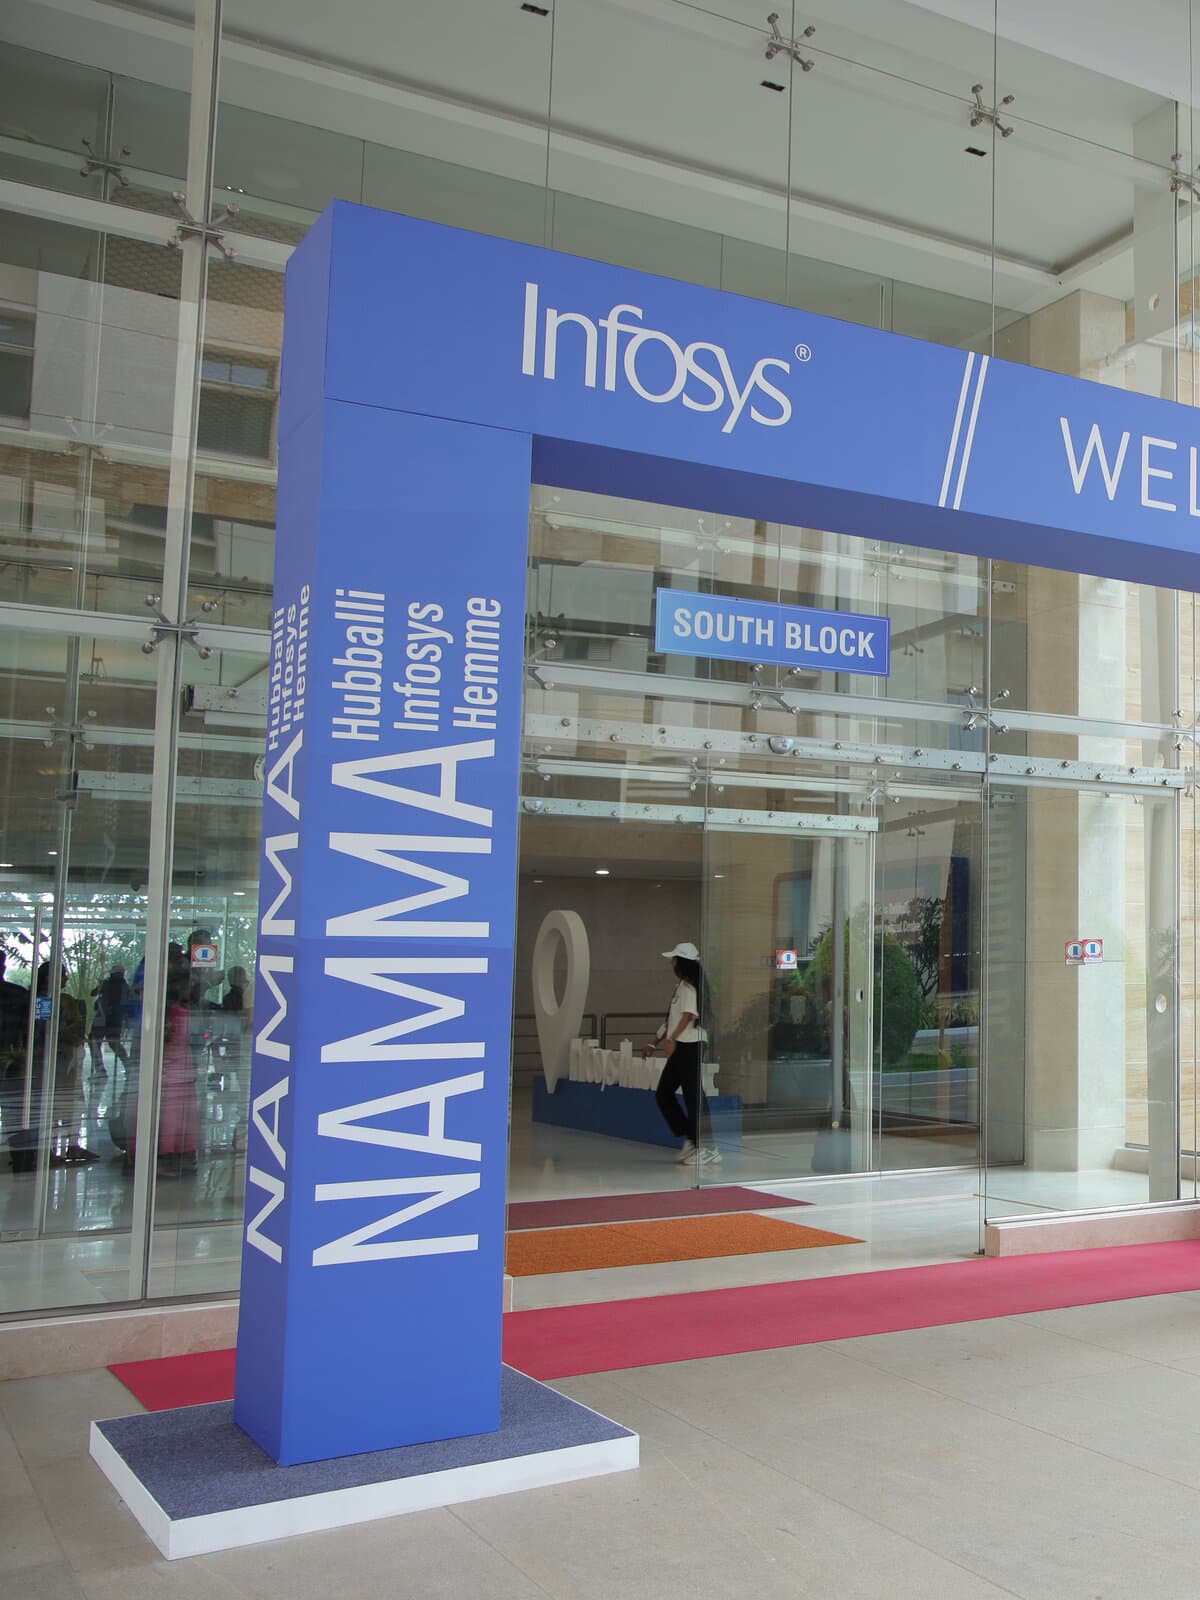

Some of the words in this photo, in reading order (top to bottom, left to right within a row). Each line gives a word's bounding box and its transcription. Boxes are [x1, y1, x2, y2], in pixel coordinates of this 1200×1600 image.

[268, 607, 285, 750] Hubballi
[280, 604, 297, 733] Infosys
[293, 584, 310, 722] Hemme
[331, 589, 385, 741] Hubballi
[393, 602, 454, 732] Infosys
[453, 597, 501, 730] Hemme
[673, 608, 774, 647] SOUTH
[785, 622, 875, 659] BLOCK
[247, 730, 303, 1264] NAMMA
[312, 739, 496, 1266] NAMMA
